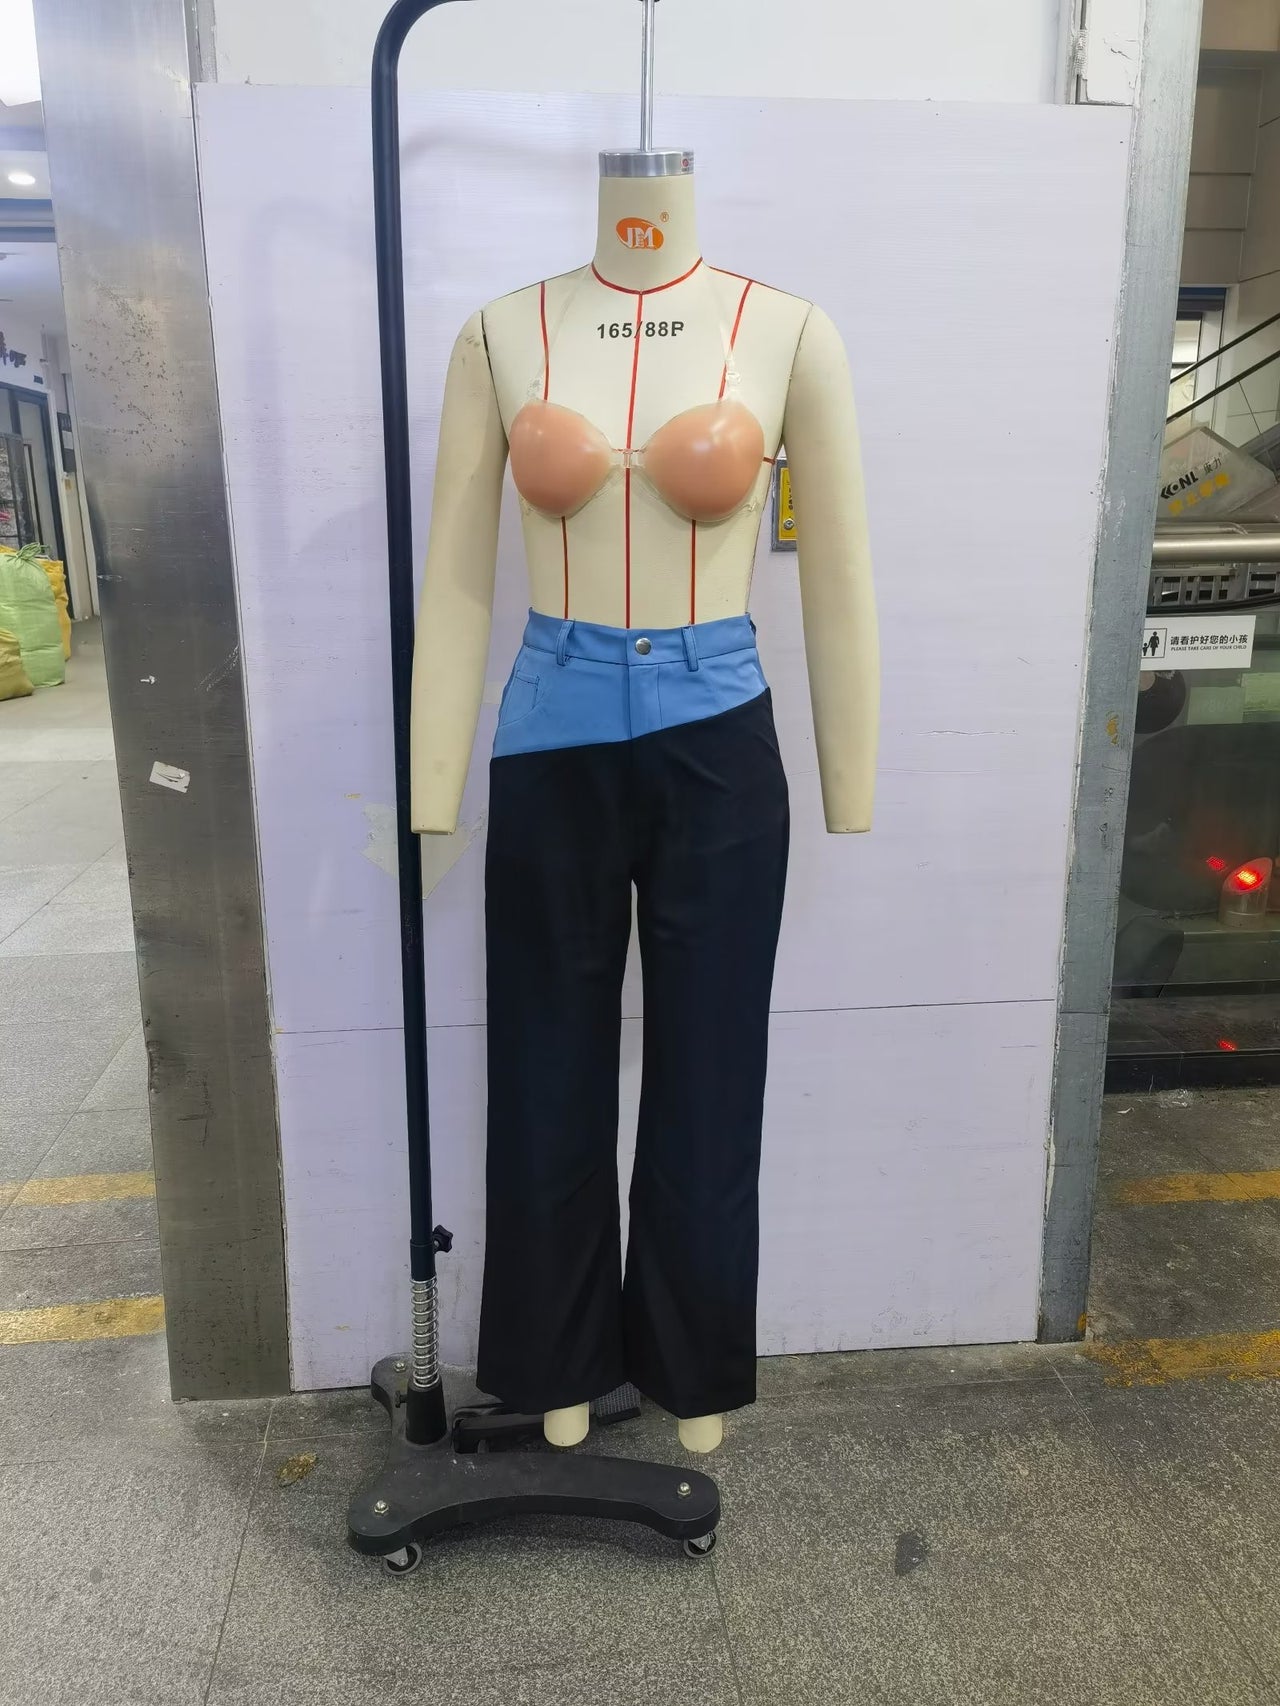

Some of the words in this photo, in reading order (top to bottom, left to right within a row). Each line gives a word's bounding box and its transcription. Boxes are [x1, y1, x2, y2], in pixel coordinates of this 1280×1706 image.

[596, 320, 685, 339] 165/88P
[1170, 634, 1249, 646] 请看护好您的小孩
